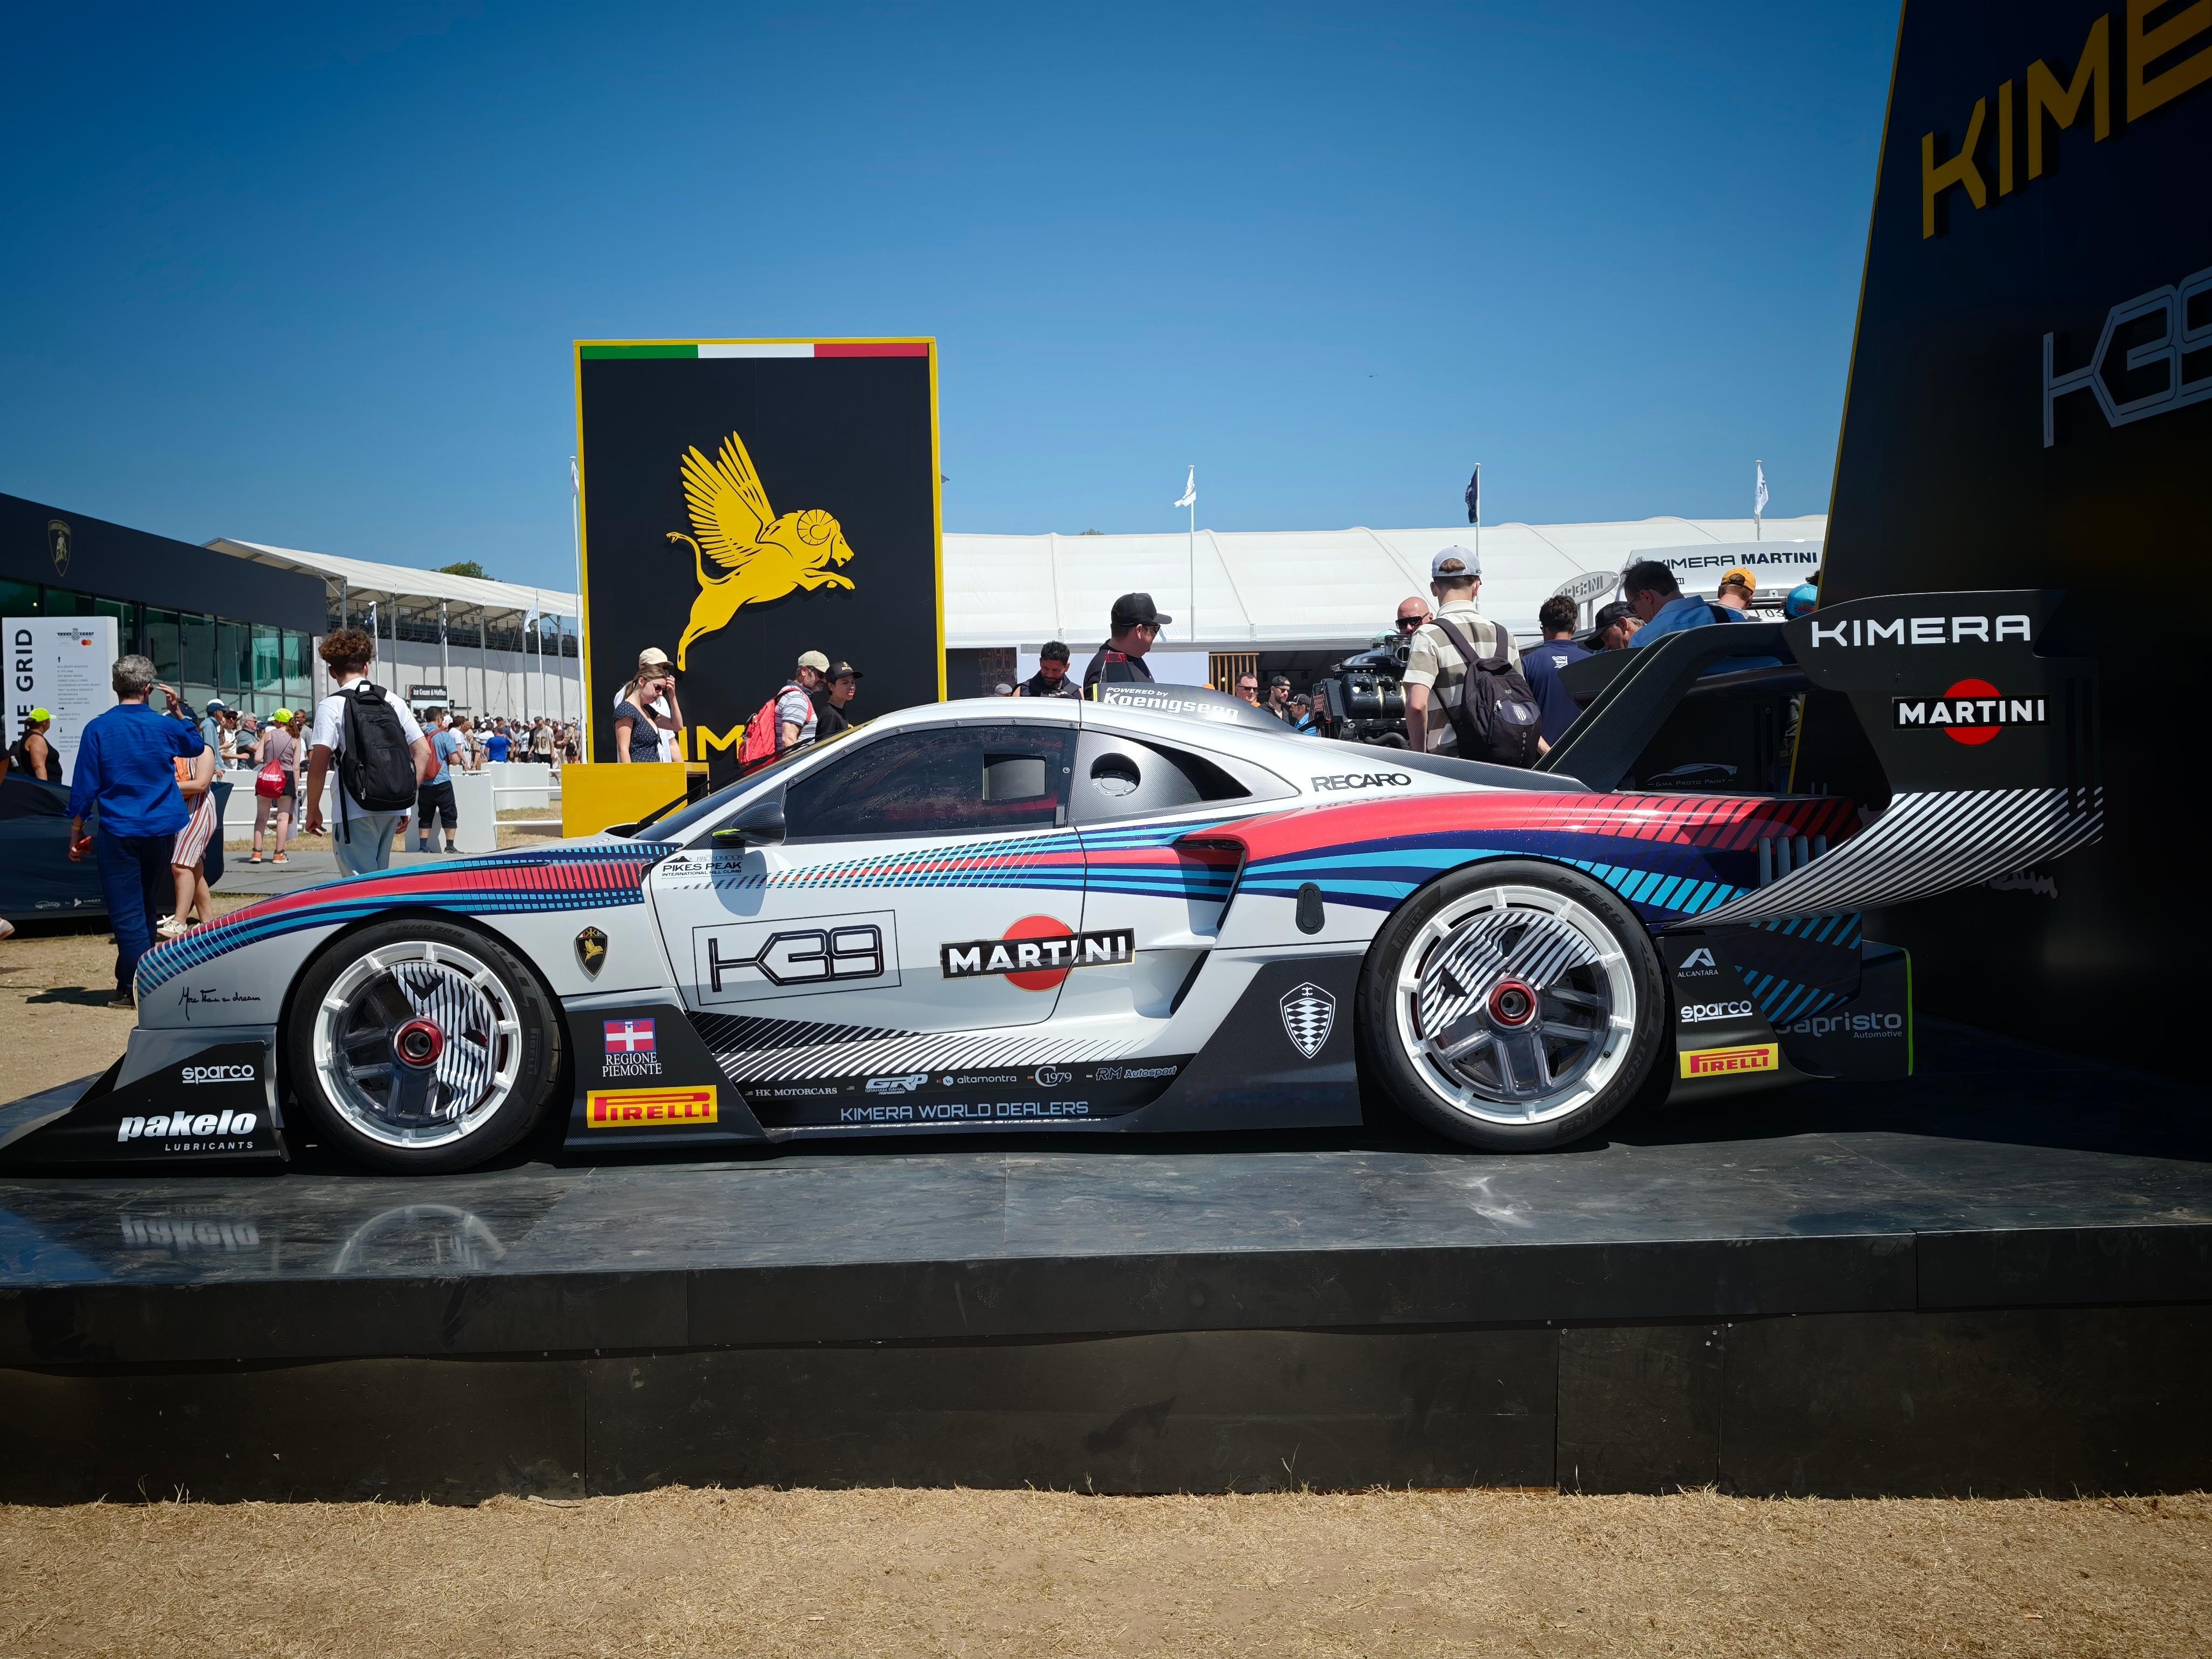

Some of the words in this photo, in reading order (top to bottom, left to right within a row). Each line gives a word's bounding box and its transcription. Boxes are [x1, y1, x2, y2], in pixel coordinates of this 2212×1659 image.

[1661, 555, 1736, 569] IMERA
[1741, 552, 1817, 565] MARTINI
[1811, 615, 2031, 648] KIMERA
[15, 629, 33, 692] GRID
[1106, 687, 1155, 695] POWERED
[1899, 699, 2045, 725] MARTINI
[17, 704, 34, 745] HE
[1311, 773, 1412, 792] RECARO
[663, 864, 702, 872] PIKES
[705, 861, 742, 870] PEAK
[1575, 885, 1626, 925] ZERO
[708, 924, 885, 993] K39
[948, 936, 1127, 974] MARTINI
[1677, 969, 1719, 978] ALCANTARA
[178, 987, 199, 1021] More
[232, 992, 261, 1001] dream
[1681, 1000, 1753, 1023] sparco
[1853, 1029, 1903, 1039] Automotive
[605, 1053, 657, 1065] REGIONE
[1690, 1048, 1770, 1074] PIRELLI
[181, 1064, 255, 1084] sparco
[602, 1063, 663, 1077] PIEMONTE
[957, 1074, 1017, 1084] altamontra
[1096, 1067, 1123, 1081] RM
[1124, 1065, 1177, 1079] Autosport
[774, 1087, 838, 1096] MOTORCARS
[865, 1074, 928, 1091] GRP
[594, 1091, 711, 1122] PIRELLI
[841, 1105, 913, 1122] KIMERA
[919, 1103, 990, 1118] WORLD
[996, 1101, 1089, 1117] DEALERS
[118, 1109, 257, 1142] pakelo
[165, 1141, 254, 1151] LUBRICANTS
